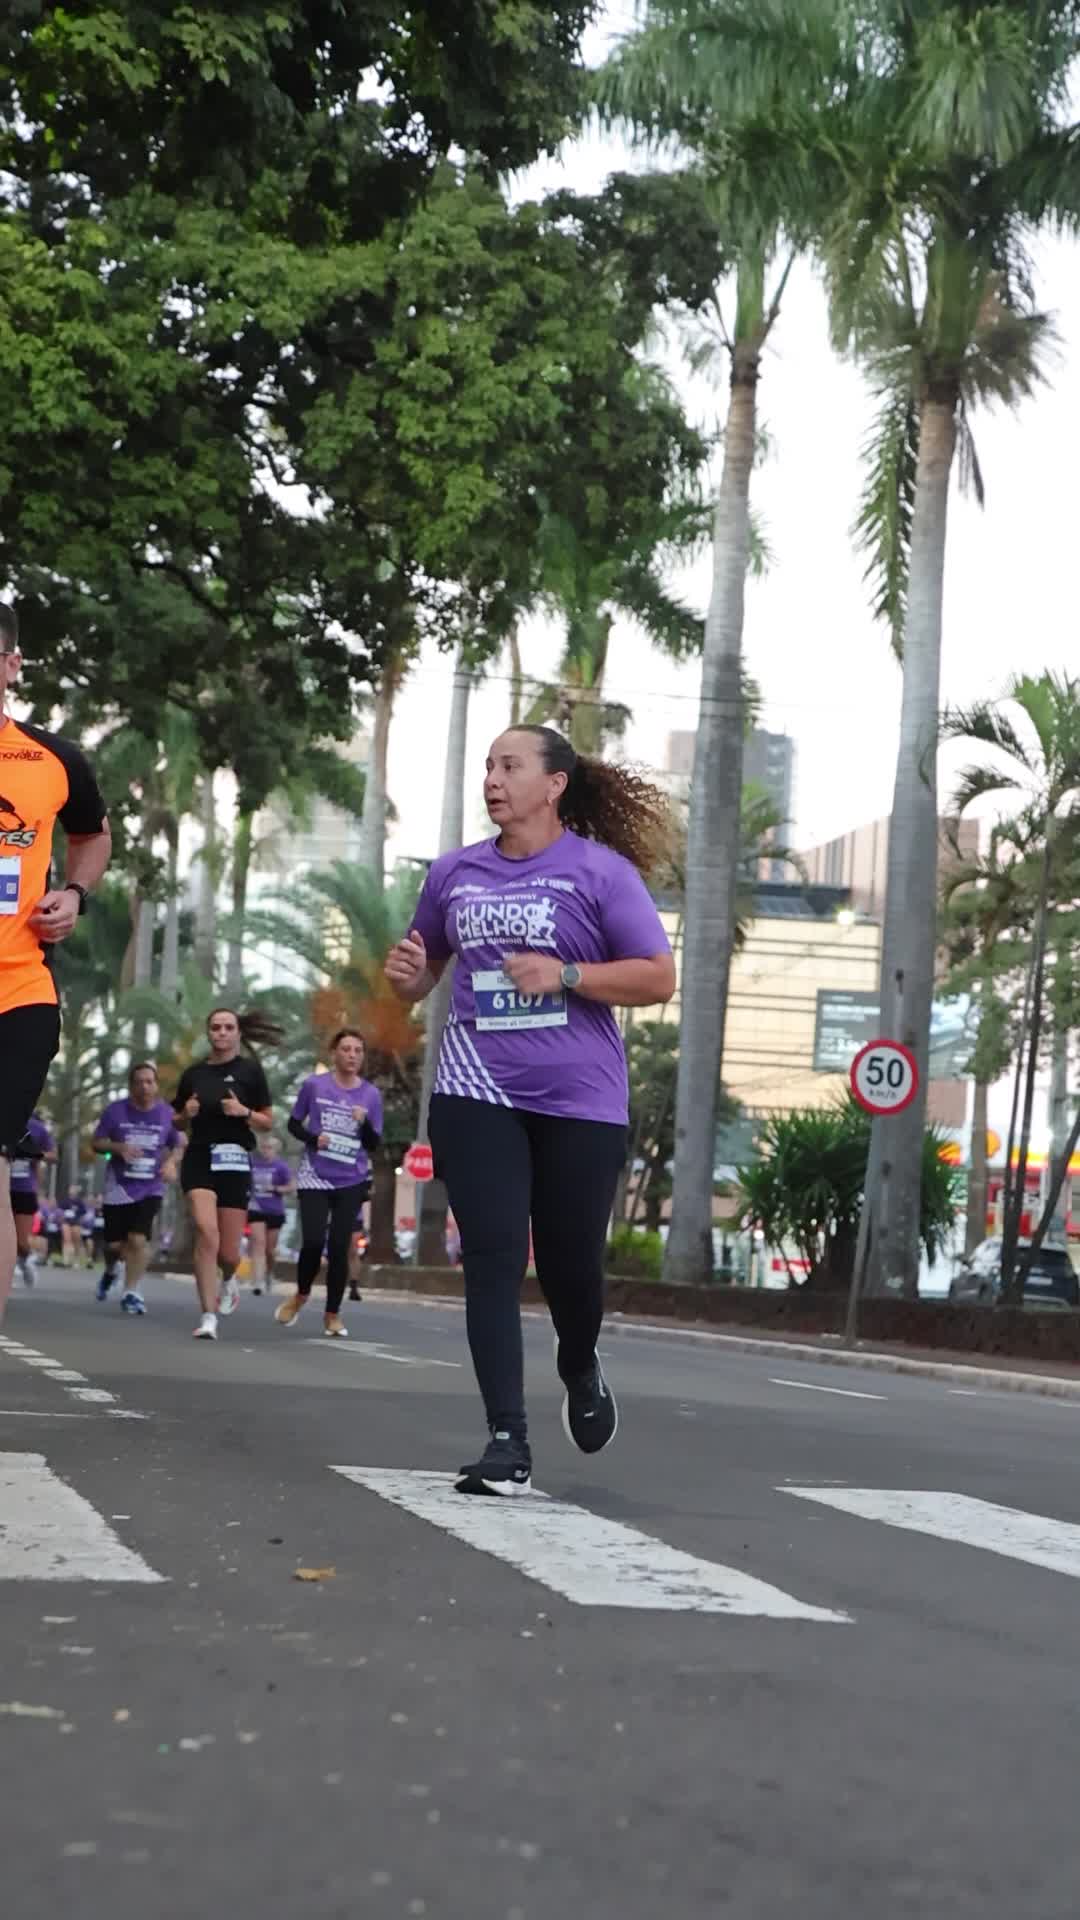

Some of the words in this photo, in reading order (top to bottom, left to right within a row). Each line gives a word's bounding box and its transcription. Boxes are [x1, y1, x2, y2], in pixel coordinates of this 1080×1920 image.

[456, 903, 540, 925] MUNDO
[457, 919, 543, 942] MELHOR
[866, 1056, 904, 1088] 50
